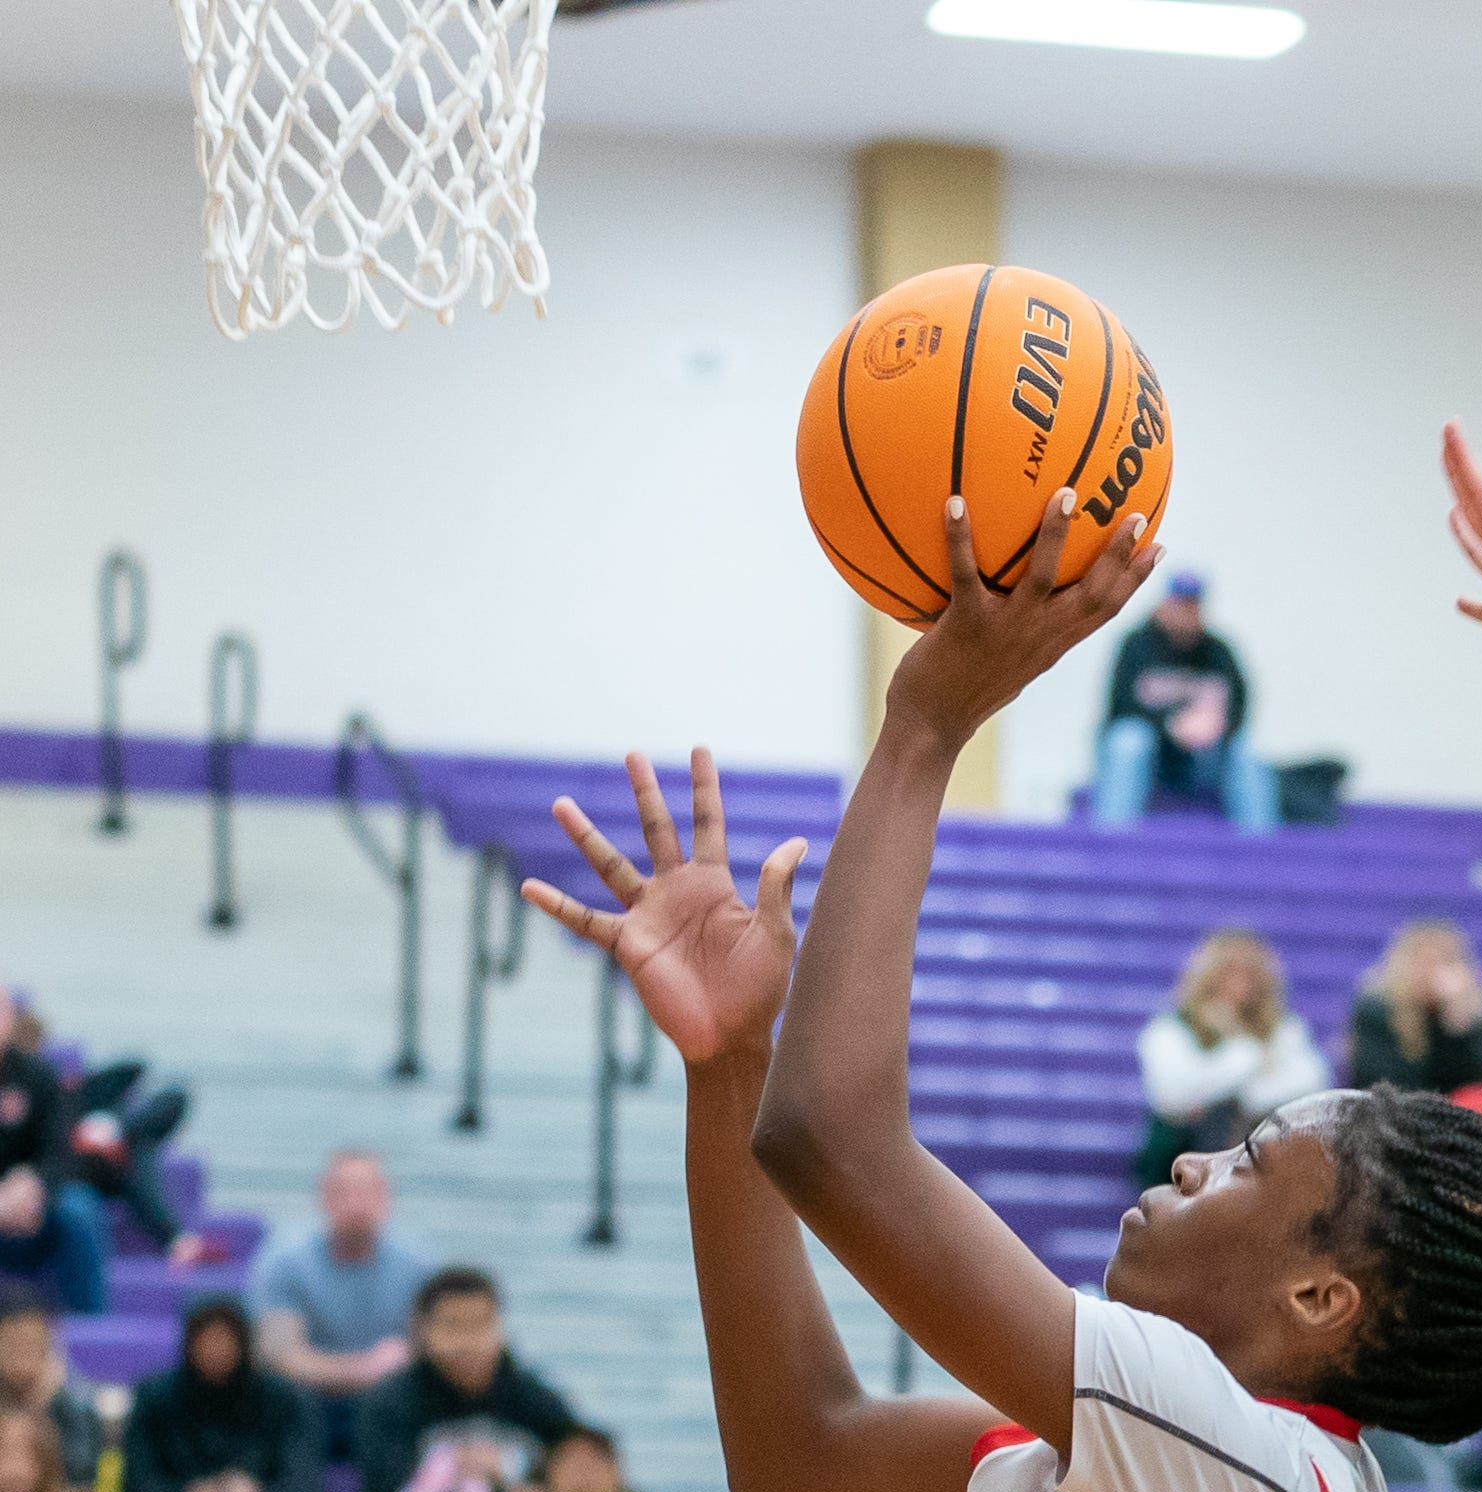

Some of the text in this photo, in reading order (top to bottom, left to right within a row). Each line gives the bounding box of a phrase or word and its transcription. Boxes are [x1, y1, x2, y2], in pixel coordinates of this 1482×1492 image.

[1012, 296, 1071, 487] EVO NXT
[1081, 332, 1165, 528] ilson
